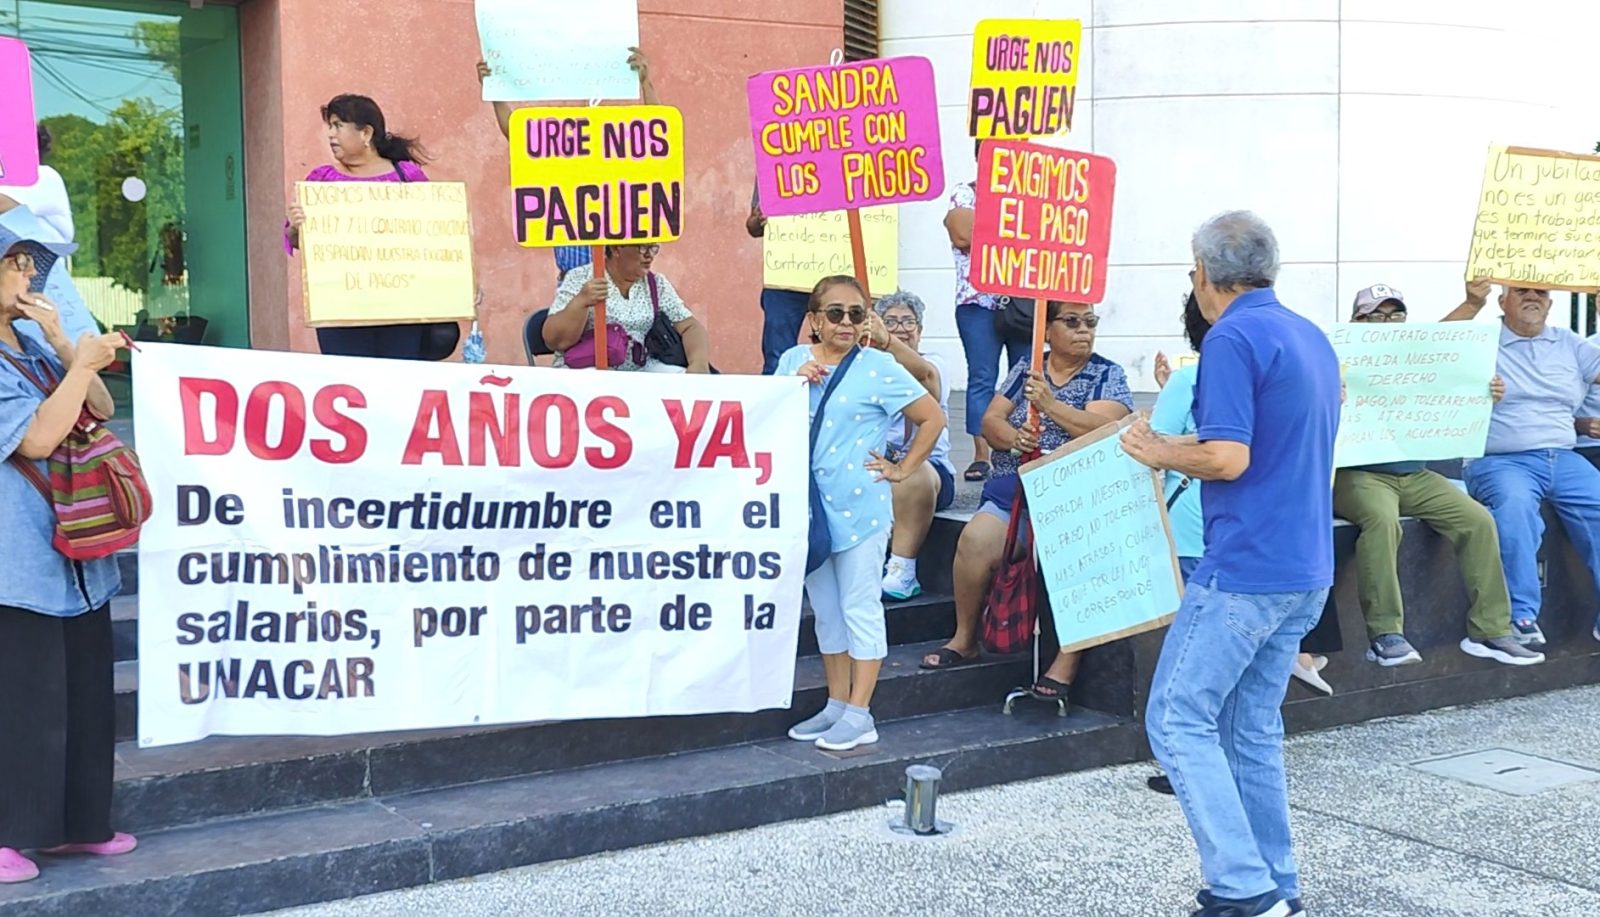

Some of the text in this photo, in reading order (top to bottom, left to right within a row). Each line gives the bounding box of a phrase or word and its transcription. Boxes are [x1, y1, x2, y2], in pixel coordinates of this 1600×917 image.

[986, 34, 1074, 73] URGE NOS
[771, 64, 899, 117] SANDRA
[969, 85, 1076, 137] PAGUEN
[526, 118, 670, 159] URGE NOS
[760, 110, 907, 156] CUMPLE CON
[775, 145, 931, 203] LOS PAGOS
[990, 147, 1090, 203] EXIGIMOS
[1494, 152, 1523, 182] Un
[514, 181, 681, 242] PAGUEN
[1478, 210, 1499, 224] es
[1508, 212, 1528, 225] un
[1485, 189, 1509, 206] no
[1514, 193, 1536, 206] es
[1545, 192, 1566, 206] un
[347, 216, 355, 233] Y
[819, 232, 837, 242] en
[998, 197, 1089, 247] EL PAGO
[1474, 228, 1498, 244] que
[765, 249, 888, 277] Contrato Coleivo
[980, 244, 1094, 295] INMEDIATO
[1474, 247, 1483, 265] y
[1486, 243, 1526, 259] debe
[1361, 329, 1429, 344] CONTRATO
[1342, 352, 1460, 368] ESPALDA NUESTRO
[1368, 372, 1437, 387] DERECHO
[178, 374, 773, 486] DOS AÑOS YA,
[1033, 477, 1050, 498] EL
[1052, 450, 1107, 488] CONTRATO
[177, 484, 781, 529] De incertidumbre en el
[177, 543, 782, 594] cumplimiento de nuestros
[176, 594, 777, 649] salarios, por parte de la
[178, 656, 376, 705] UNACAR
